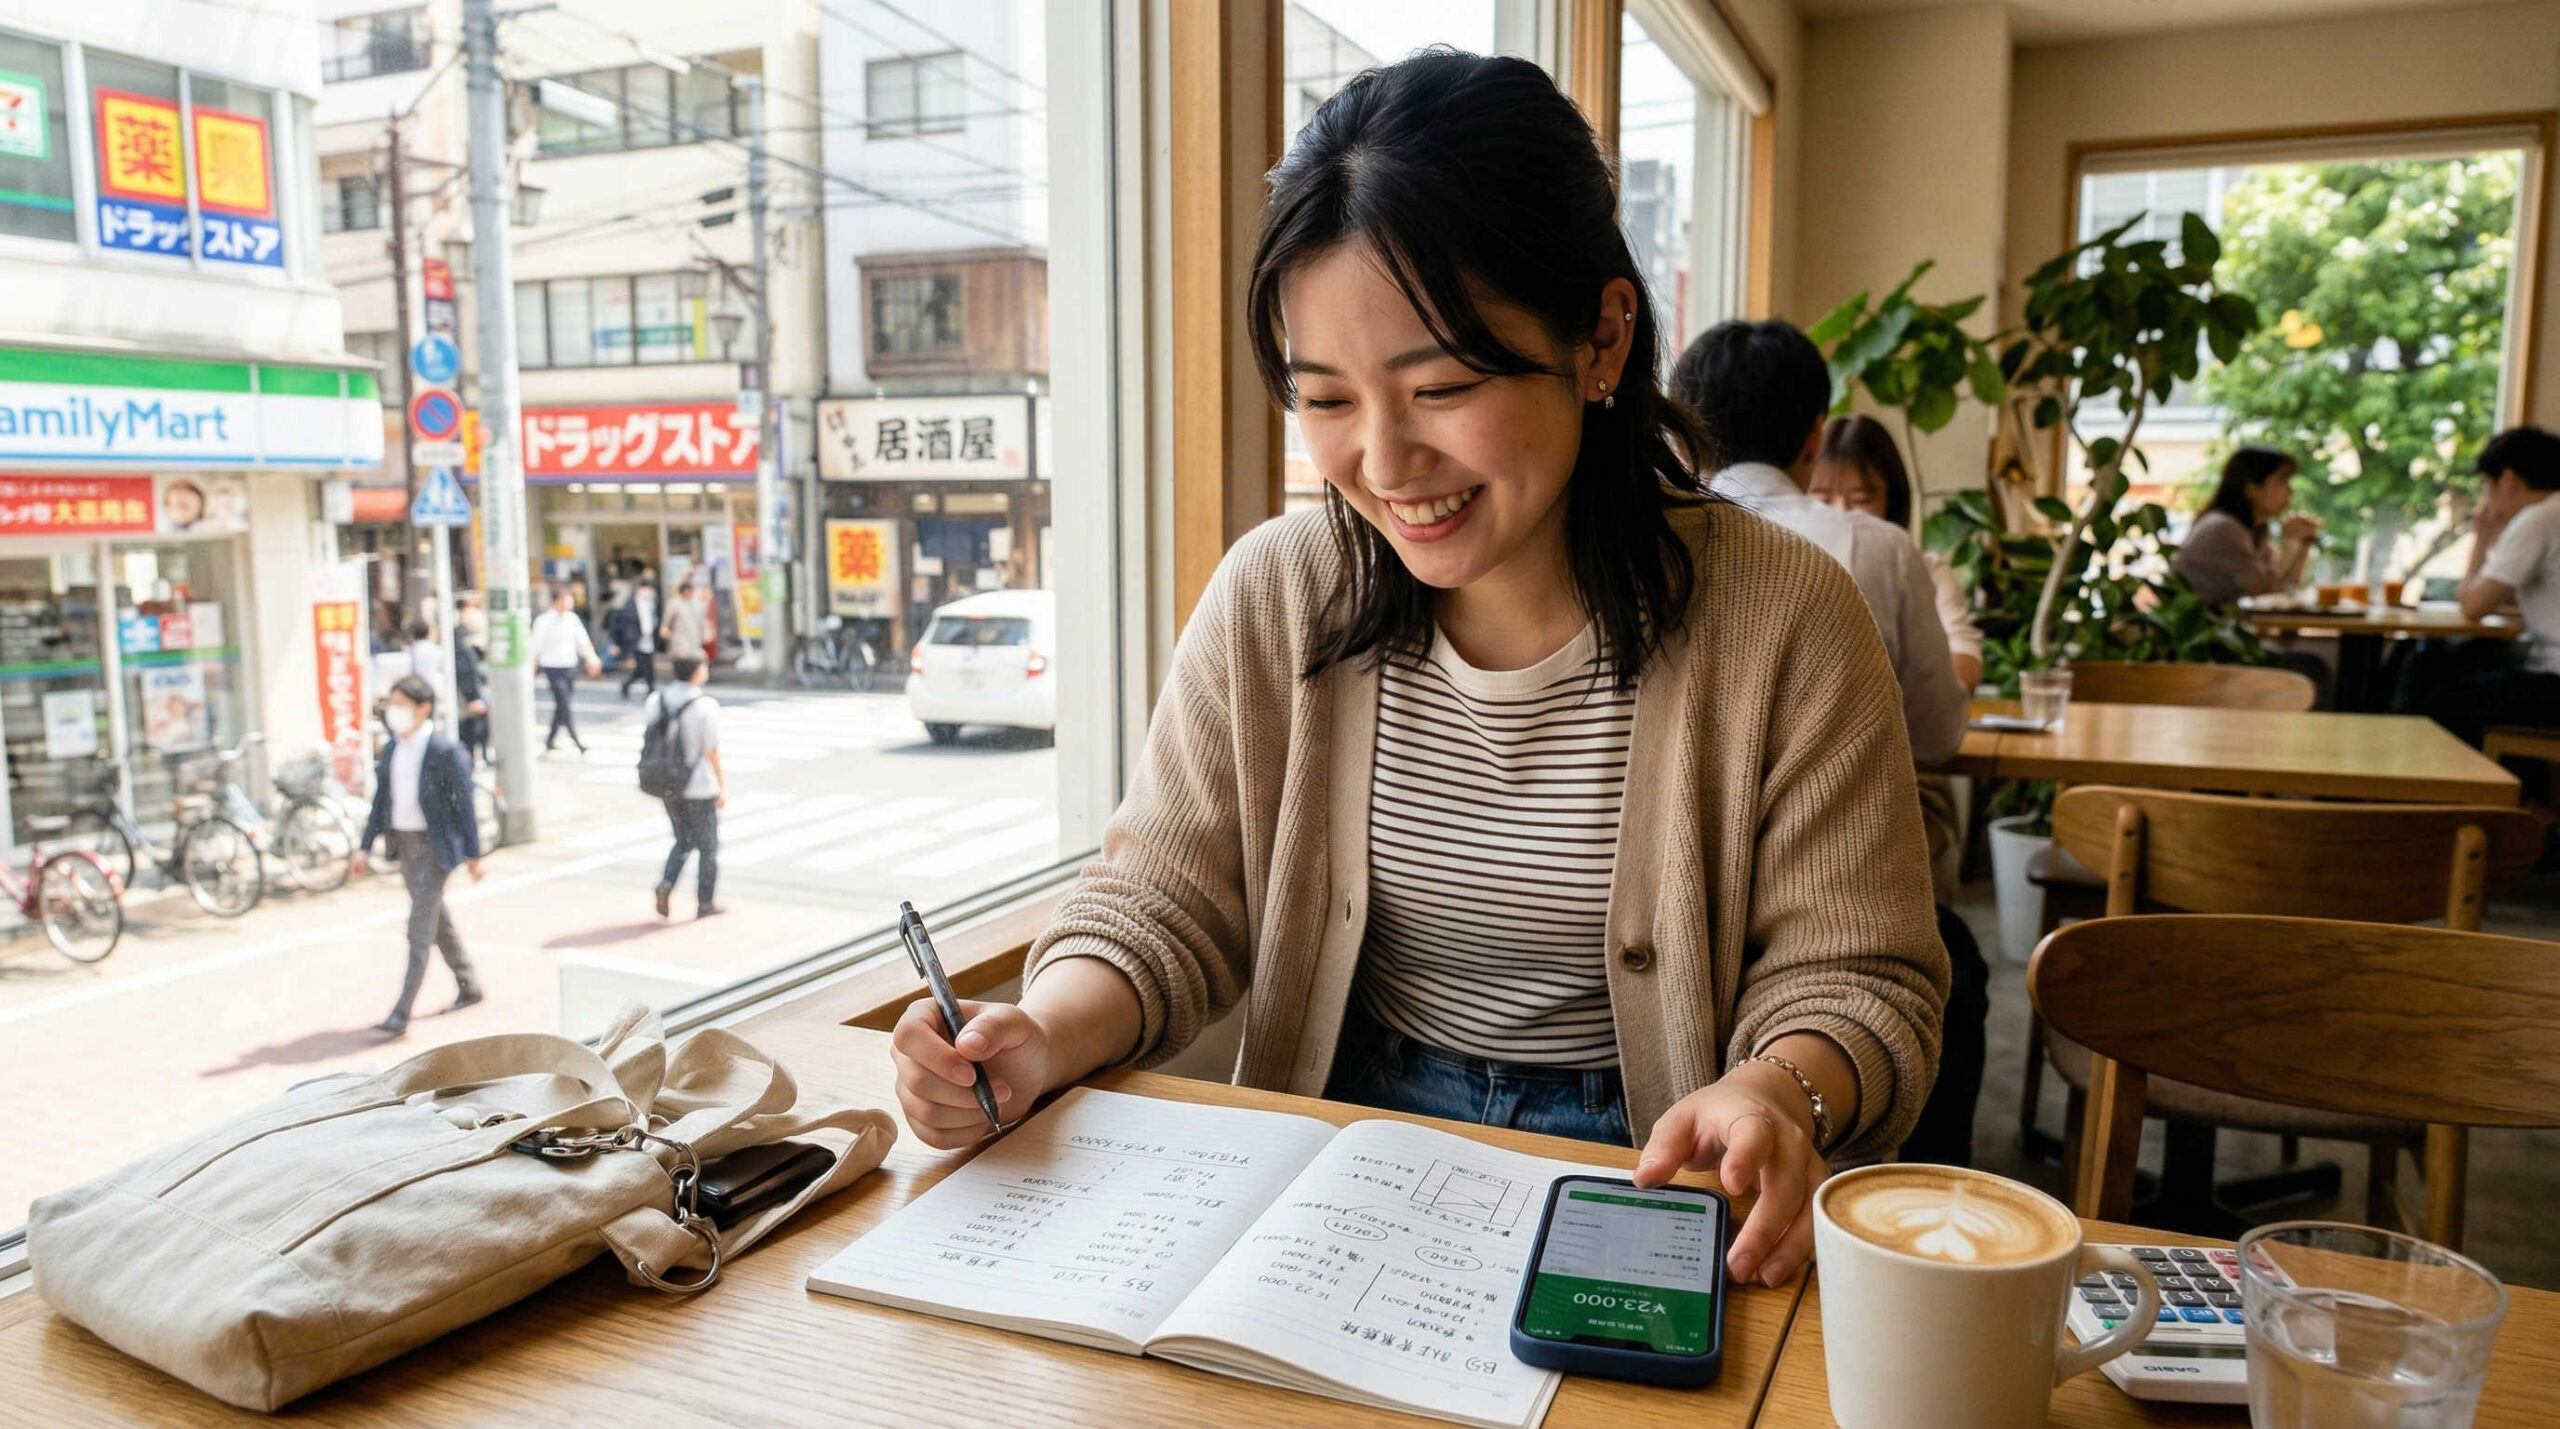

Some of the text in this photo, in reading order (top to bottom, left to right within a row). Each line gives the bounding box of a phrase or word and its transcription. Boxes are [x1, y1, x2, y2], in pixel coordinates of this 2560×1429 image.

[115, 113, 174, 182] 薬
[0, 396, 229, 448] amilyMart
[876, 416, 996, 463] 居酒屋
[2152, 1262, 2168, 1271] 2
[2205, 1278, 2220, 1287] 4
[2225, 1293, 2237, 1302] 7
